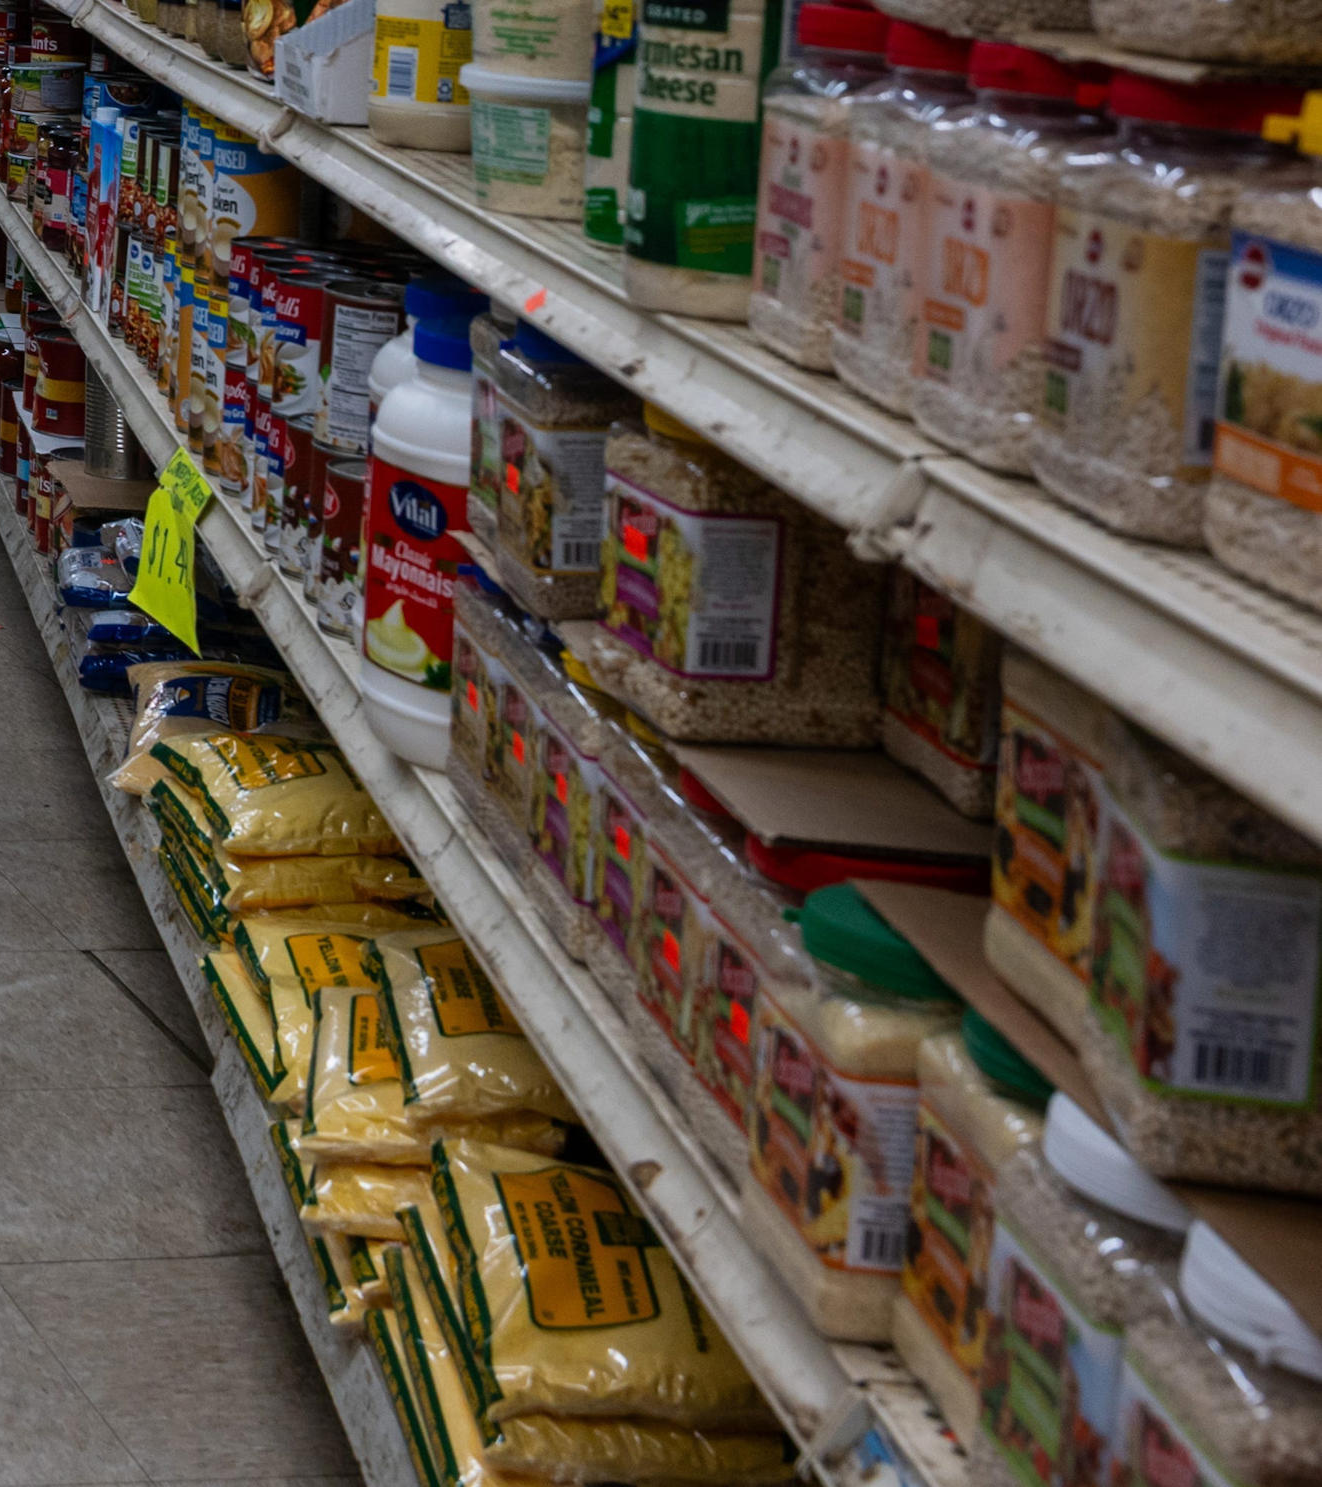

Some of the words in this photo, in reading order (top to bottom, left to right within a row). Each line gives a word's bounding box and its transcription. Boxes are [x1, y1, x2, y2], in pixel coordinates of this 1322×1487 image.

[33, 36, 57, 51] unts
[391, 492, 440, 531] Vital
[395, 540, 432, 567] Classic
[316, 937, 341, 974] YELLOW
[534, 1201, 568, 1259] COARSE
[565, 1216, 605, 1319] CORNMEAL
